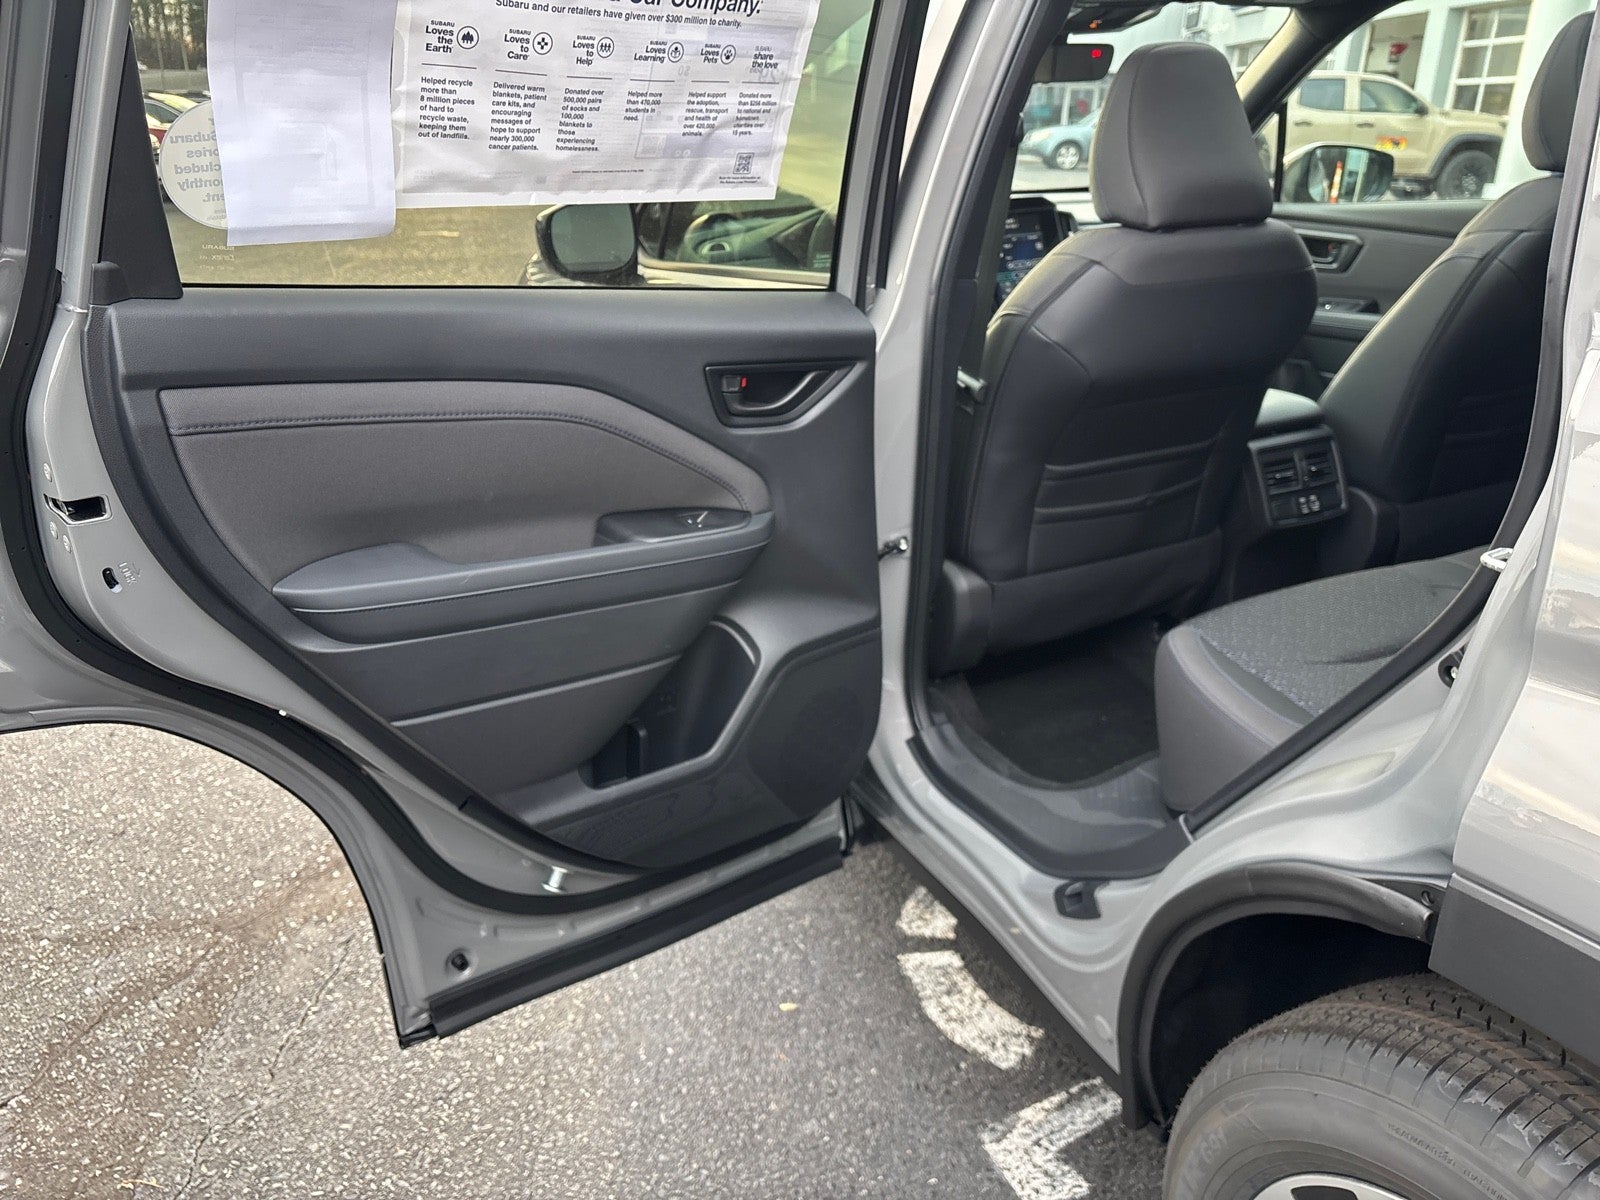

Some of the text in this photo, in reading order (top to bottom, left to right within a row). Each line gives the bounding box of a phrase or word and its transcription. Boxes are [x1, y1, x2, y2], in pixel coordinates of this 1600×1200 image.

[496, 0, 529, 9] Subaru
[532, 3, 549, 12] and
[568, 6, 601, 16] retailers
[604, 9, 622, 18] have
[625, 12, 646, 21] given
[666, 14, 682, 23] $300
[684, 16, 707, 25] million
[718, 19, 741, 29] charity.
[426, 26, 454, 36] Loves
[438, 35, 453, 45] the
[504, 34, 530, 44] Loves
[426, 43, 452, 53] Earth
[573, 40, 594, 49] Loves
[646, 45, 666, 54] Loves
[508, 51, 528, 60] Care
[634, 53, 665, 63] Learning
[703, 56, 717, 64] Pets
[754, 52, 774, 60] share
[576, 57, 593, 66] Help
[752, 60, 778, 69] the love
[421, 76, 473, 88] Helped recycle
[494, 82, 525, 90] Delivered
[493, 91, 522, 99] blankets,
[688, 91, 706, 99] Helped
[419, 123, 447, 131] keeping
[491, 126, 506, 134] hope
[490, 135, 509, 143] nearly
